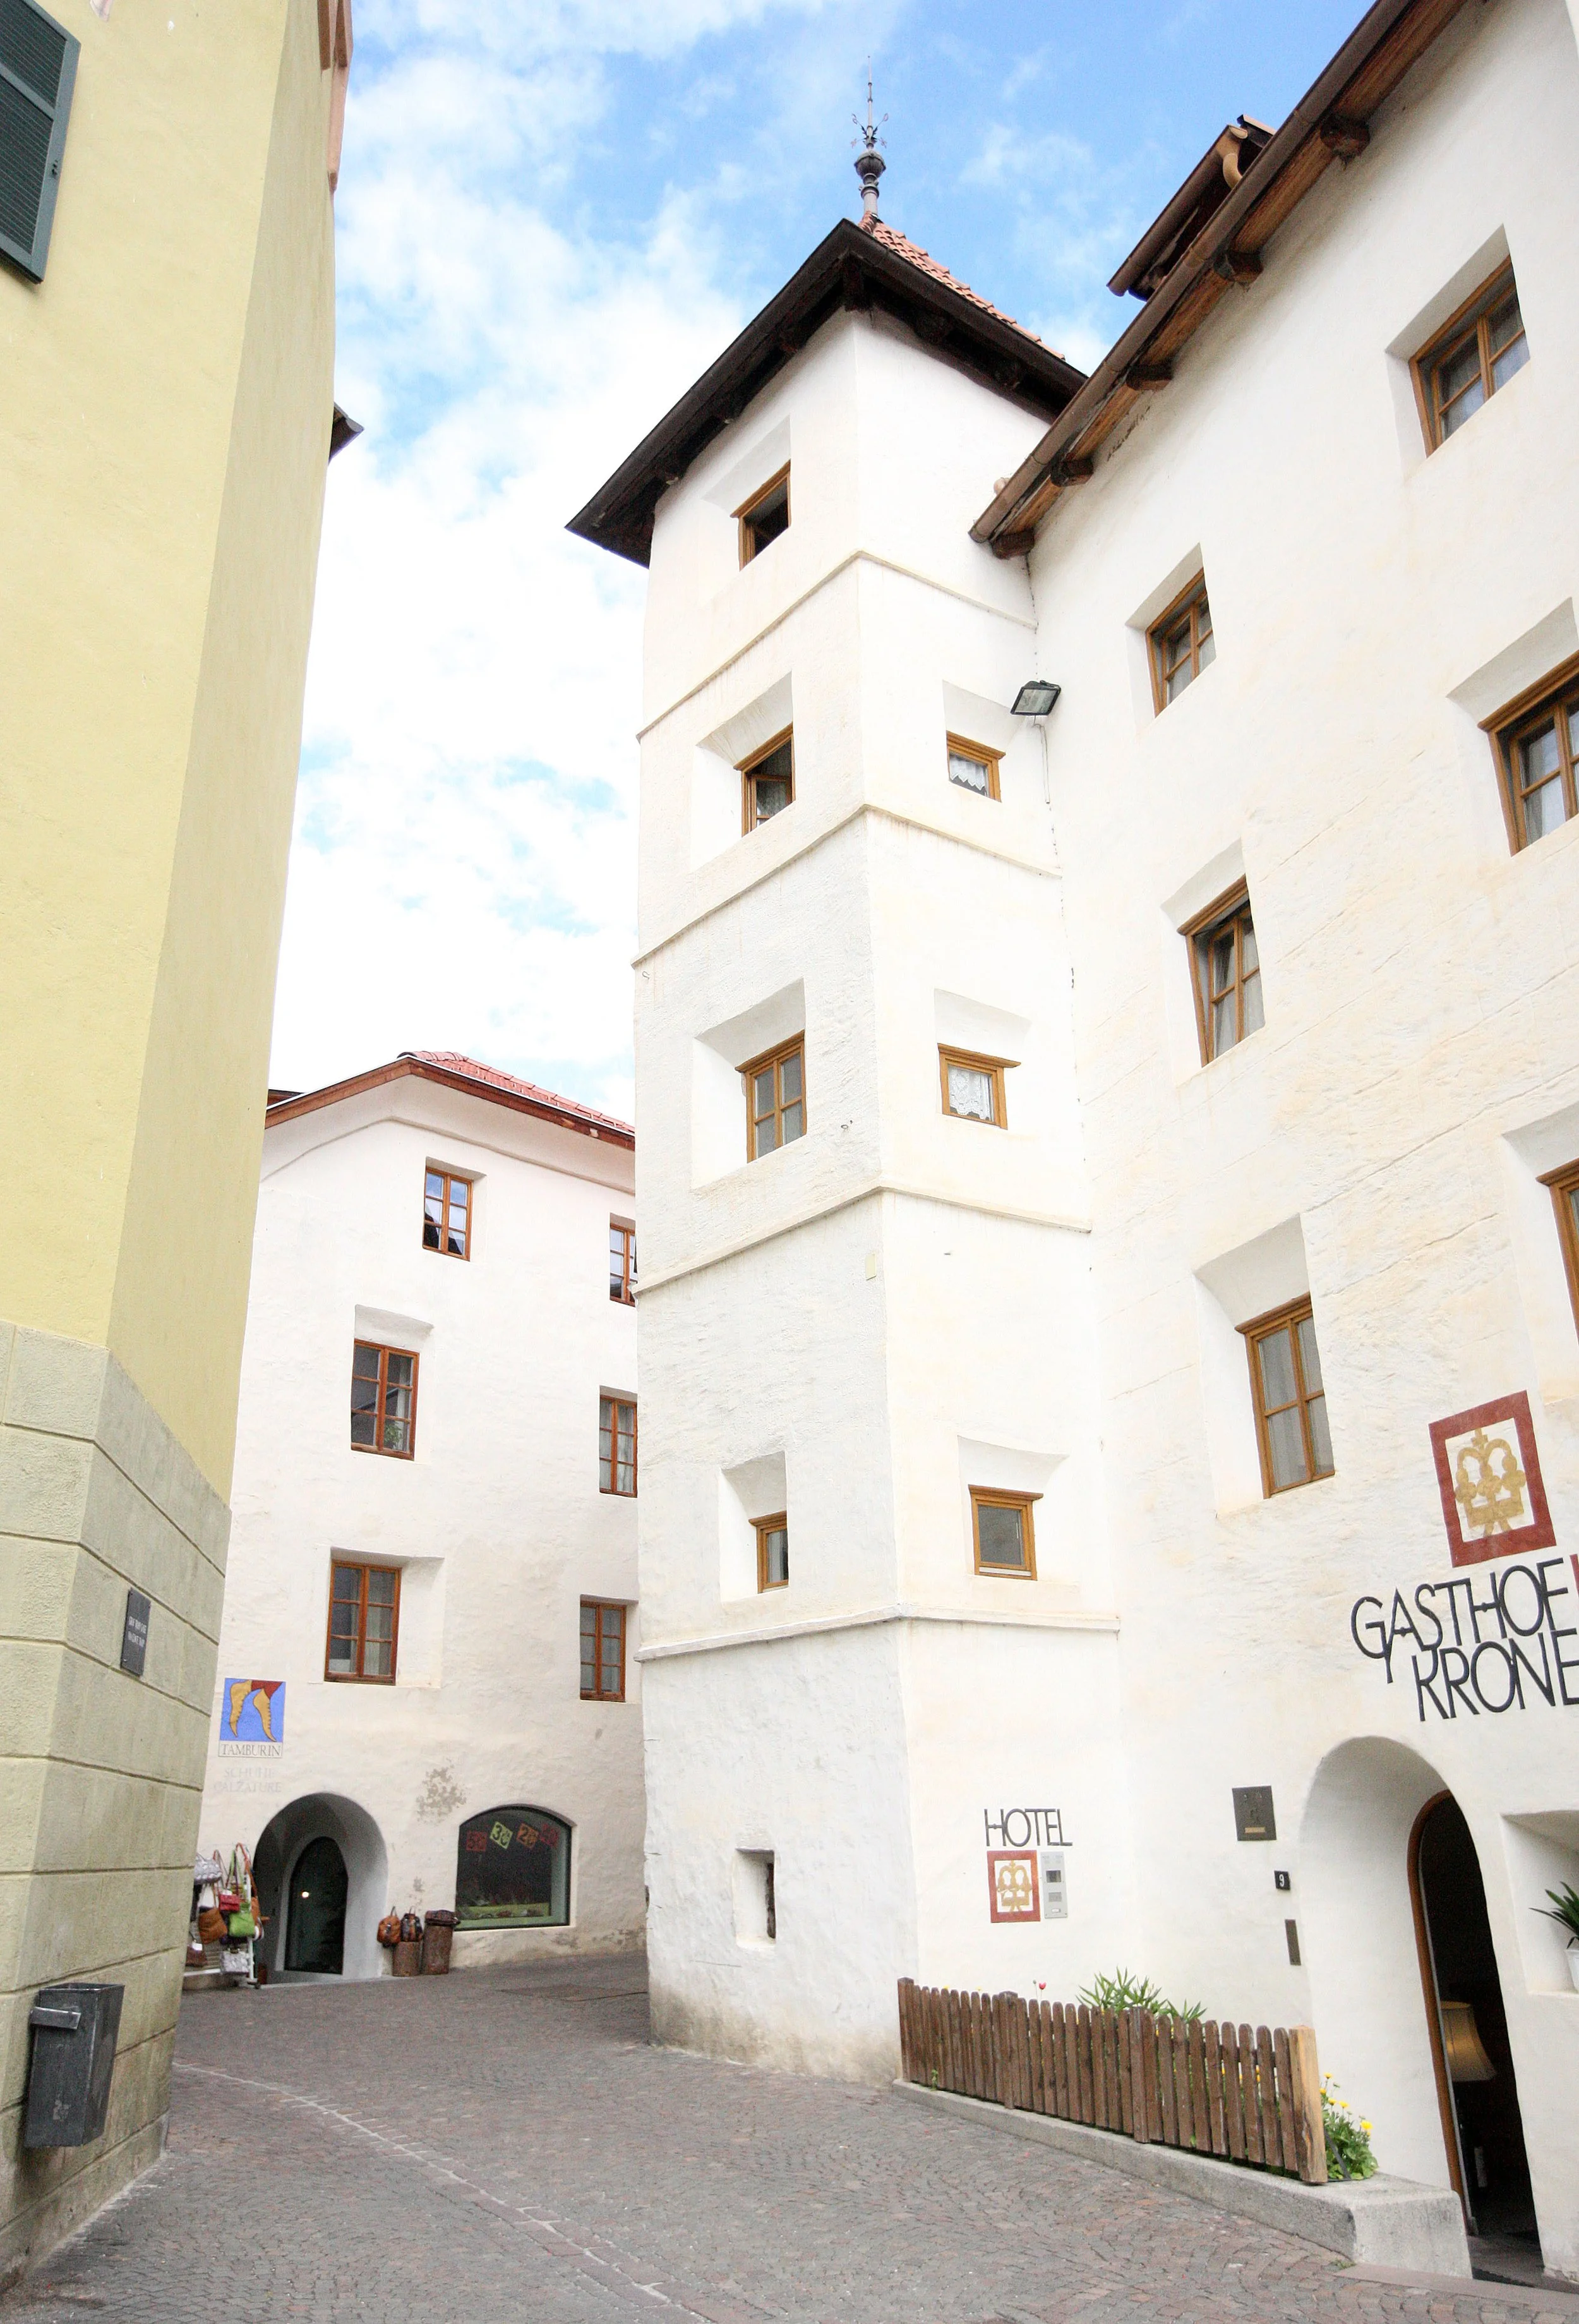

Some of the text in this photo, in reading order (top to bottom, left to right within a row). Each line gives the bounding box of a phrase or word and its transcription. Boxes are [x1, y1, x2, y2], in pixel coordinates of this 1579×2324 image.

[1351, 1558, 1569, 1683] GASTHOF
[1411, 1628, 1579, 1722] KRONE
[221, 1743, 280, 1757] TAMBURIN
[213, 1781, 282, 1793] CALZATURE
[984, 1809, 1073, 1847] HOTEL
[1279, 1874, 1285, 1887] 9
